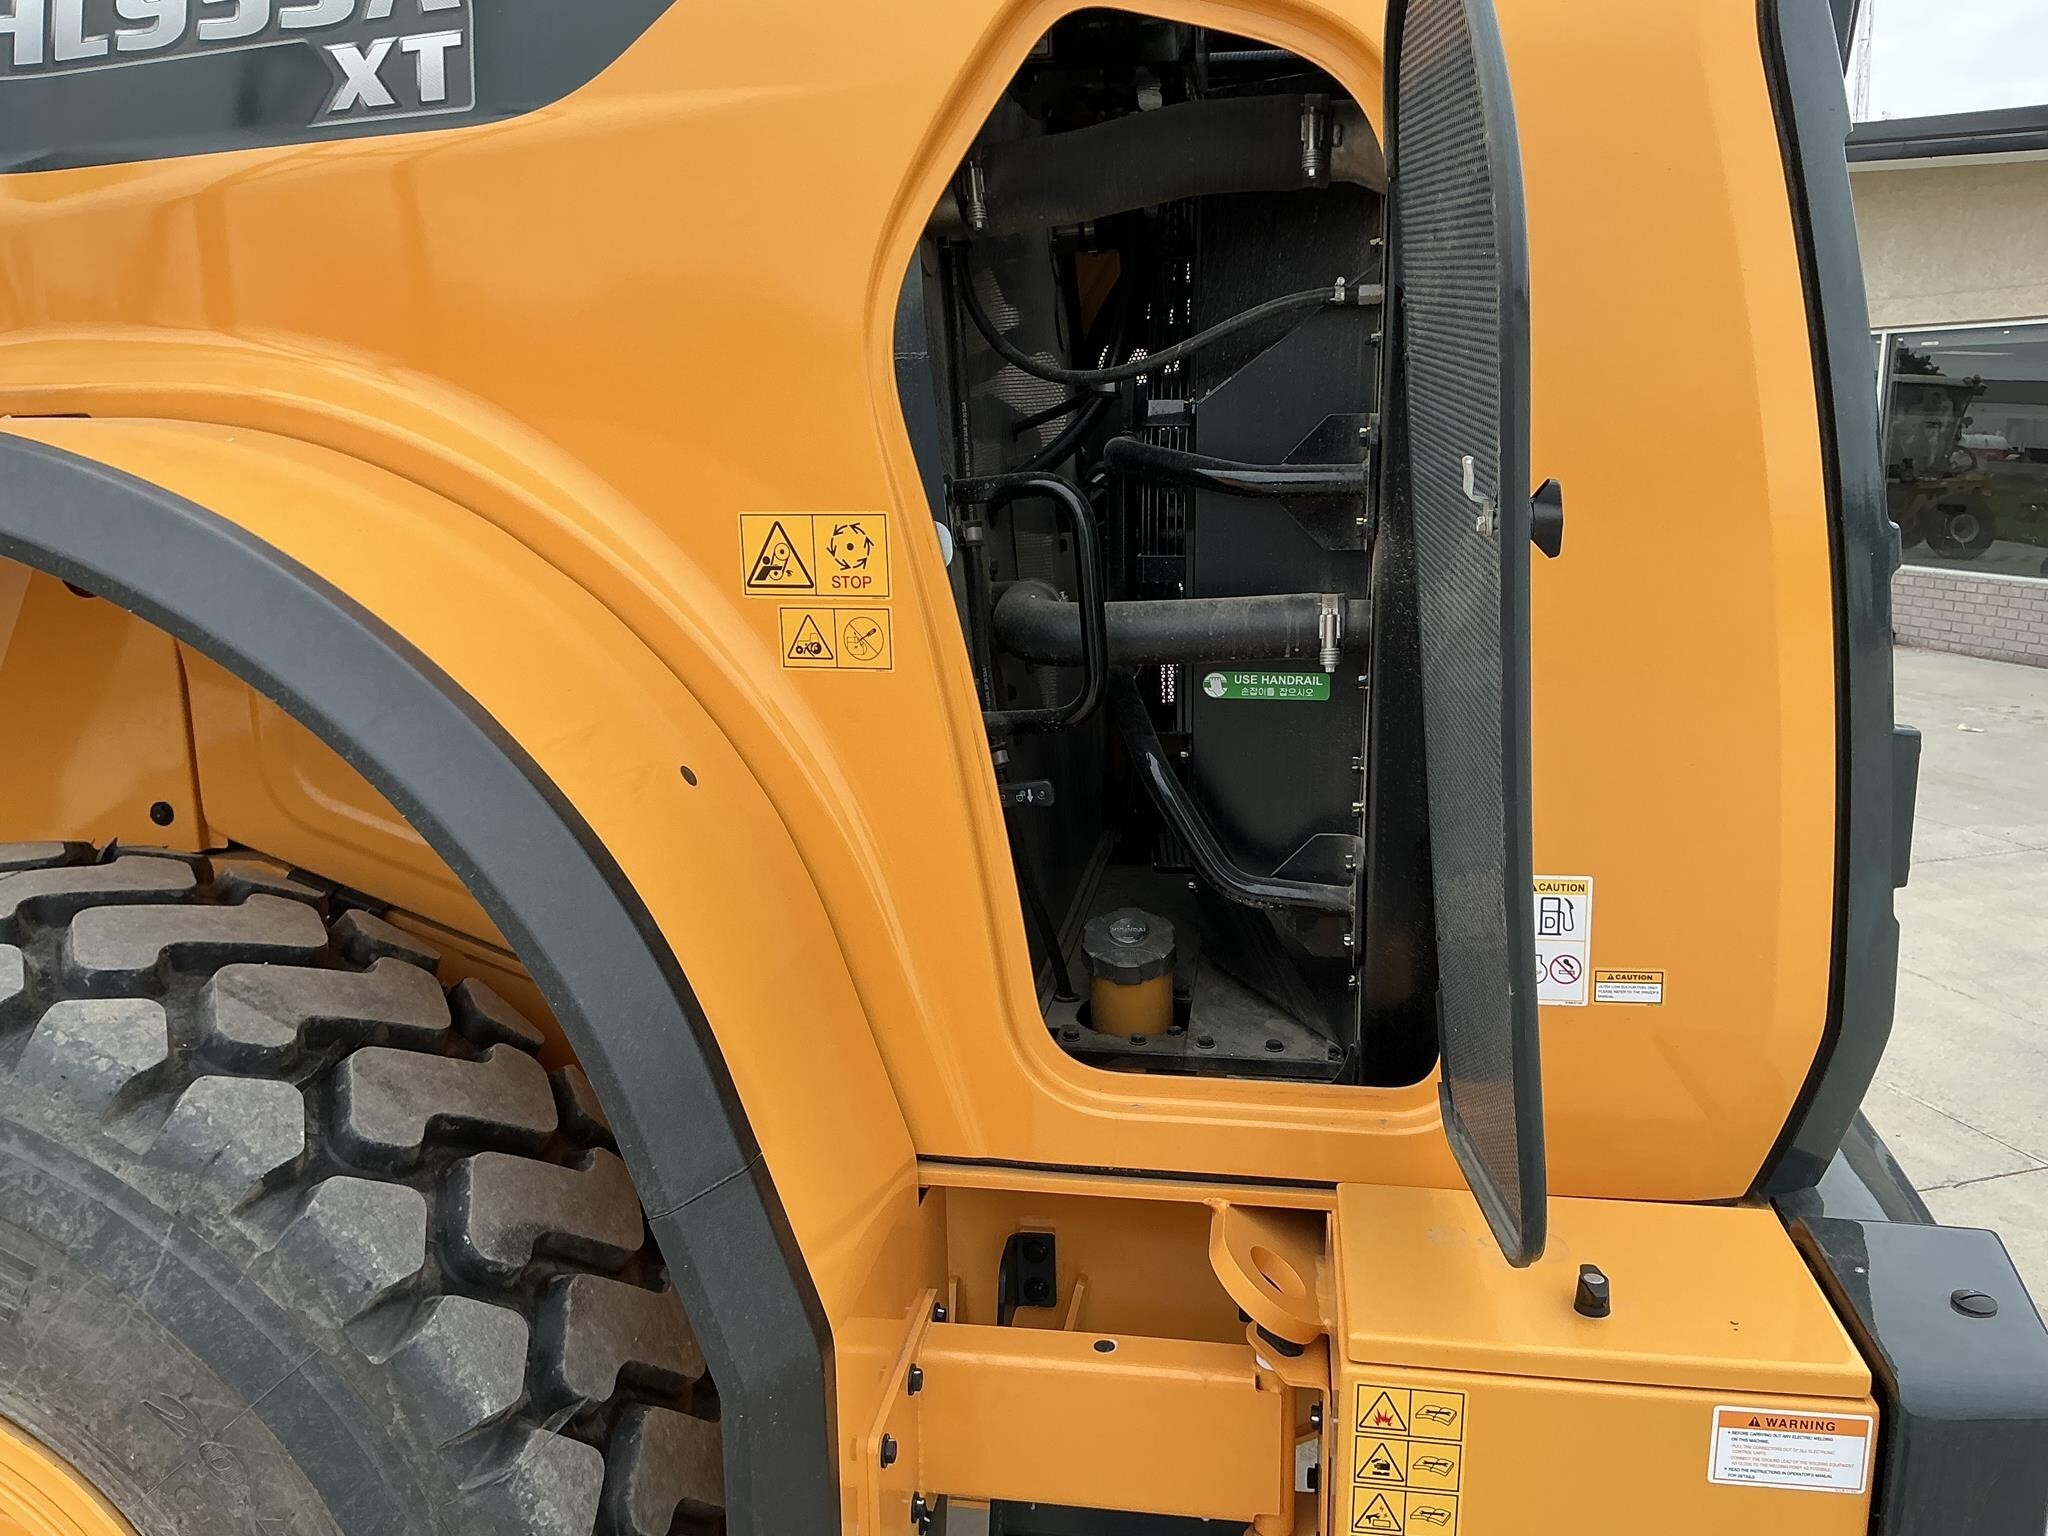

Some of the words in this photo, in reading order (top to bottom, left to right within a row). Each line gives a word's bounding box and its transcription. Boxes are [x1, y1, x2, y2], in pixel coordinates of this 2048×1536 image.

[324, 30, 463, 113] XT
[831, 576, 872, 589] STOP
[1234, 674, 1258, 685] USE
[1261, 675, 1323, 686] HANDRAIL
[1279, 687, 1314, 697] 잡으시오
[1538, 883, 1585, 892] CAUTION
[1765, 1417, 1836, 1431] WARNING
